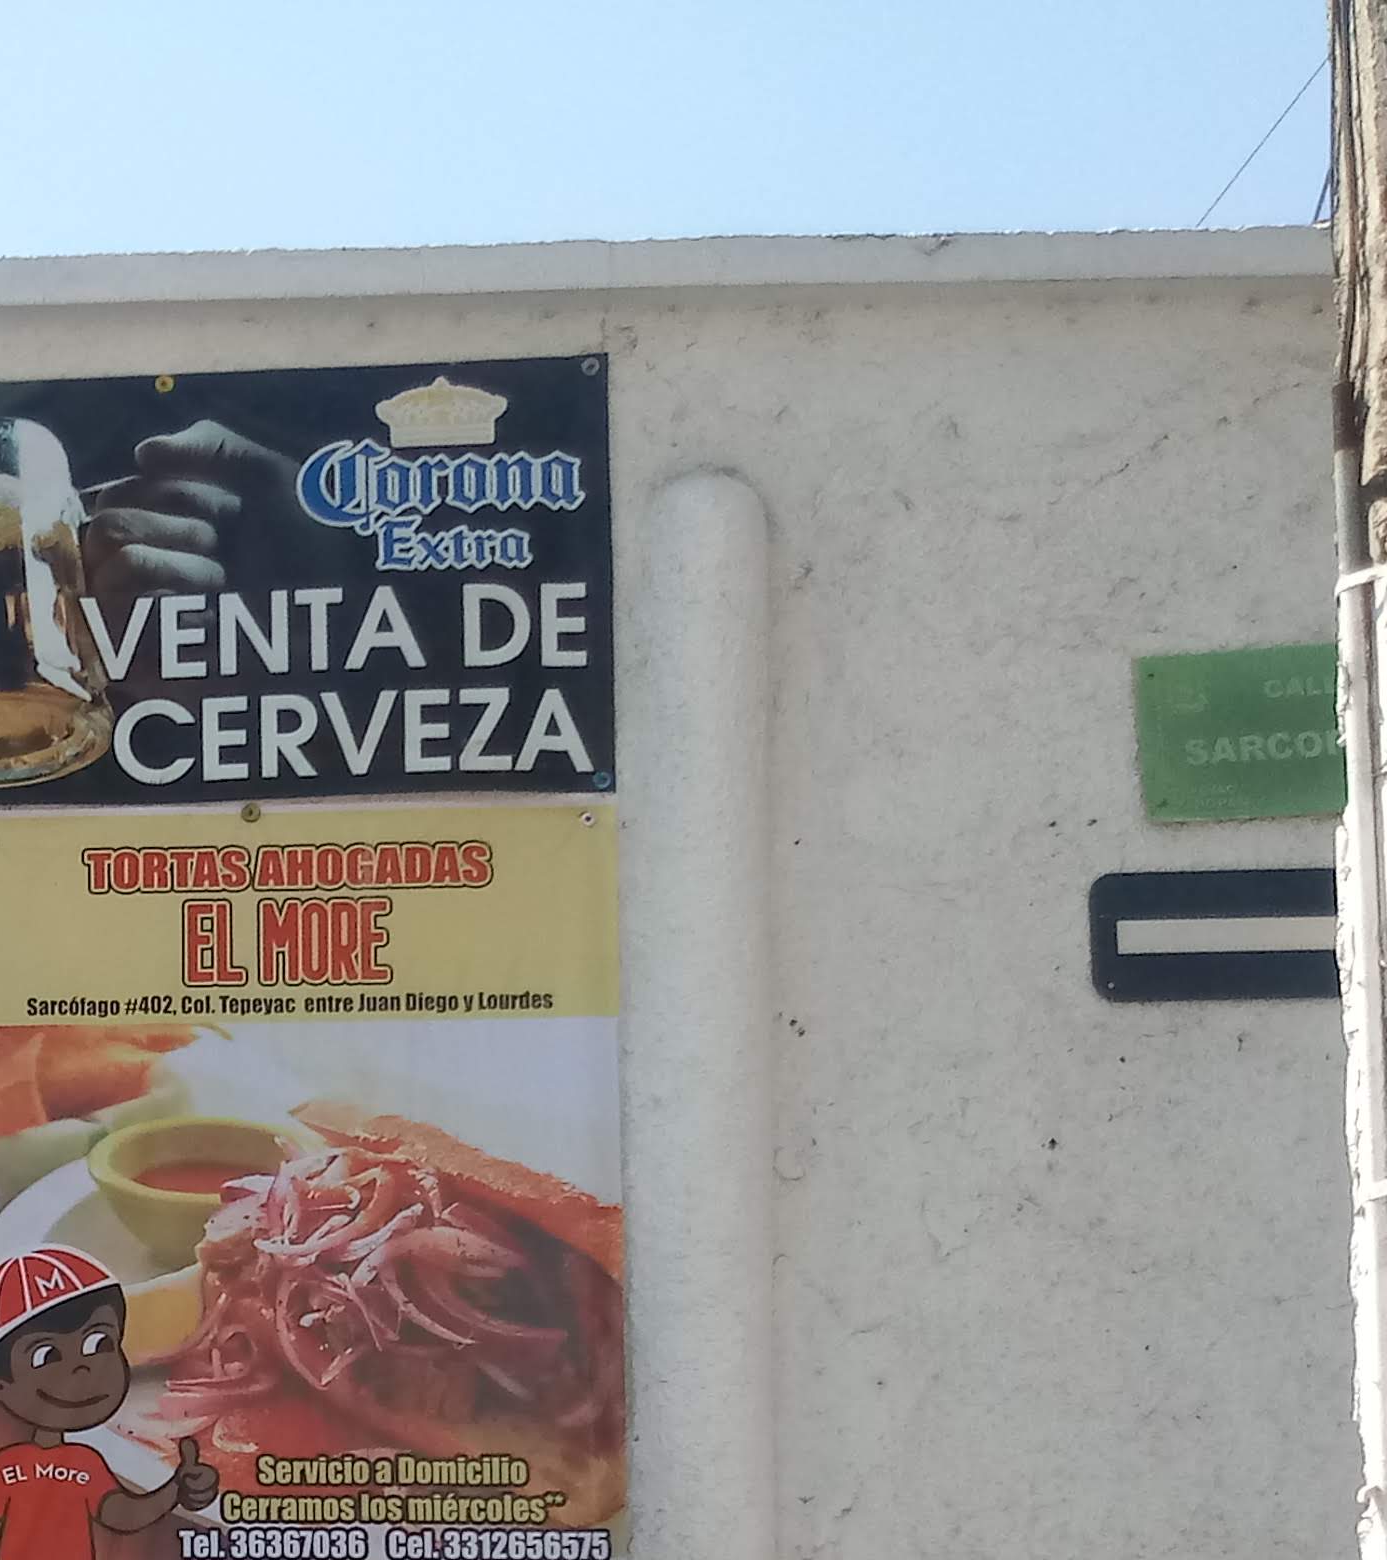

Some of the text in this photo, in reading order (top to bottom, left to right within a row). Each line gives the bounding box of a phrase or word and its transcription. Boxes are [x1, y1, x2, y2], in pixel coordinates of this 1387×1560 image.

[295, 436, 584, 535] Corona
[377, 517, 534, 572] Extra
[79, 582, 590, 681] VENTA DE
[112, 686, 595, 786] CERVEZA
[84, 843, 491, 893] TORTAS AHOGADAS
[183, 897, 393, 986] EL MORE
[27, 990, 554, 1018] Sarcófago #402, Col. Tepeyac entre Juan Diego y Lourdes
[1, 1463, 90, 1485] EL More
[257, 1456, 528, 1486] Servicio a Domicilio
[222, 1494, 356, 1523] Cerramos
[360, 1494, 405, 1522] los
[179, 1530, 611, 1560] Tel. 36367036 Cel. 3312656575
